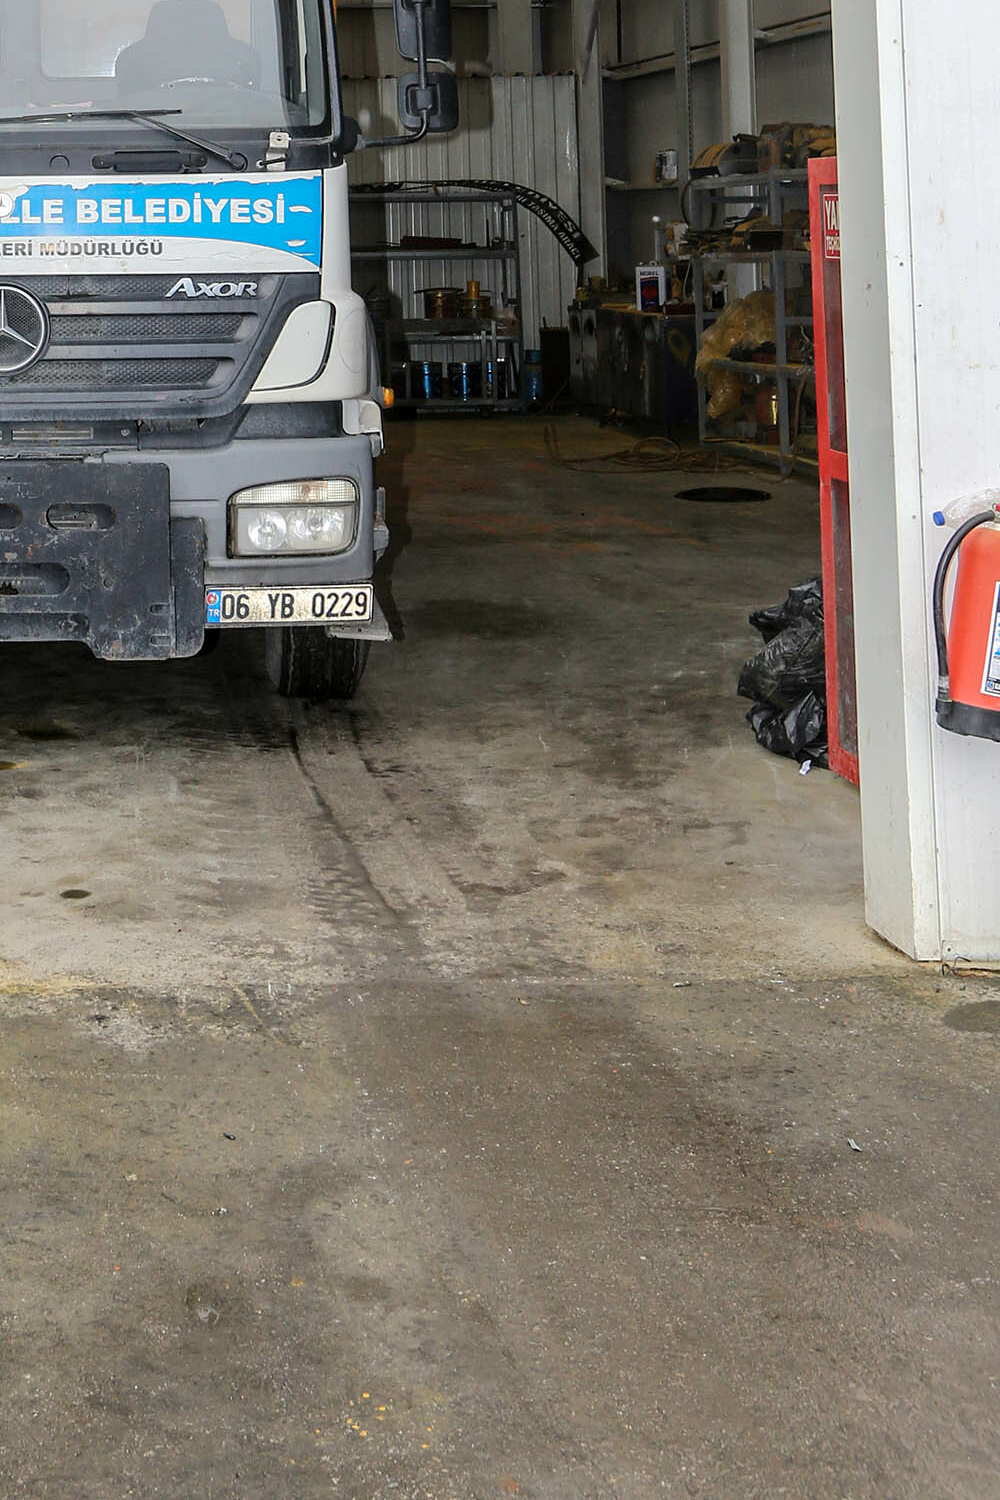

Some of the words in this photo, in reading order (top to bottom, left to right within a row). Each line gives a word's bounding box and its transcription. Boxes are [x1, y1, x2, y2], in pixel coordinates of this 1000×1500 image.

[77, 192, 285, 224] BELEDİYESİ
[39, 238, 163, 257] MÜDÜRLÜĞÜ
[209, 608, 220, 617] TR
[222, 594, 250, 619] 06
[268, 593, 295, 619] YB
[312, 592, 368, 618] 0229
